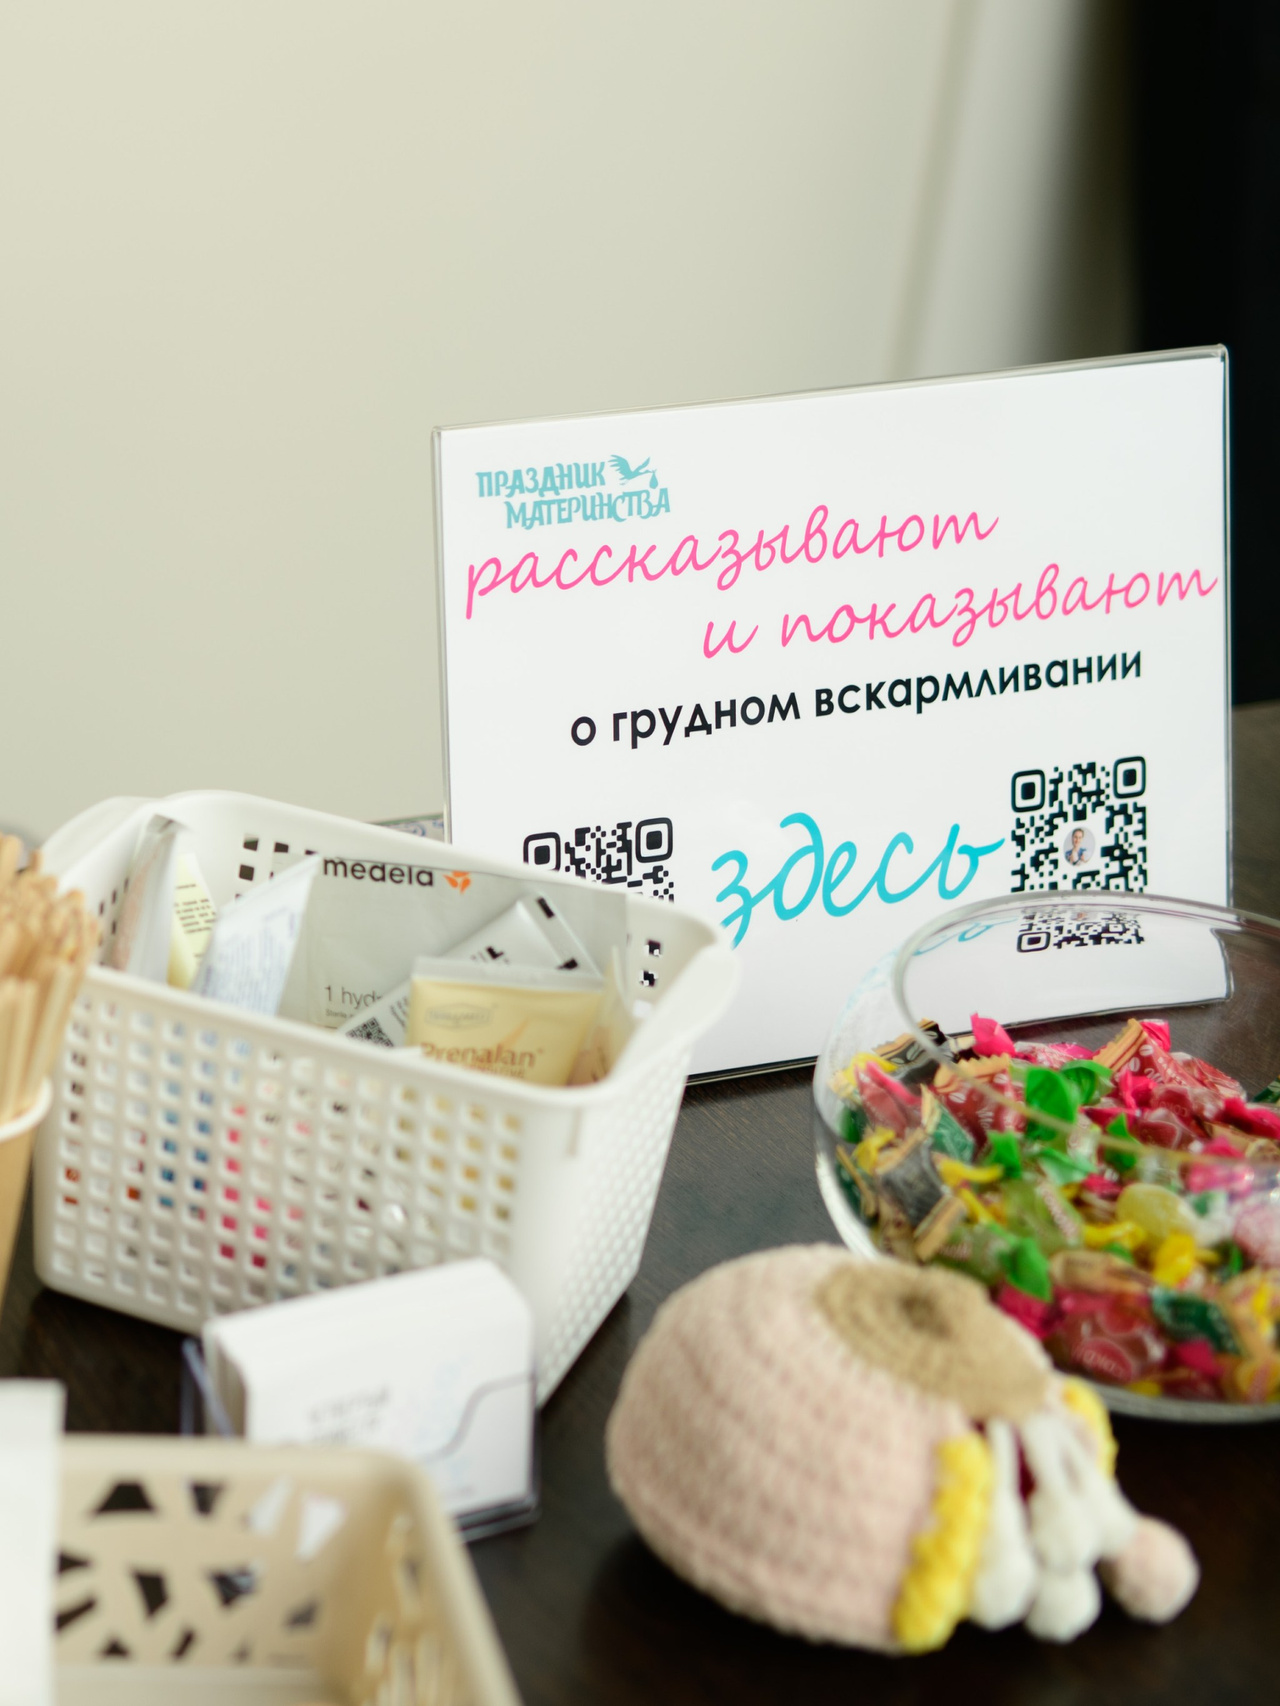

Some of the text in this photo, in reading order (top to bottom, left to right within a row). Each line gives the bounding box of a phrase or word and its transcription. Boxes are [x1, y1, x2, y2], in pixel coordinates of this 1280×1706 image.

[475, 461, 606, 498] ПРАЗДНИК
[504, 487, 671, 530] МАТЕРИНСТВА
[465, 504, 1000, 620] рассказывают
[702, 561, 1218, 660] и показывают
[570, 651, 1142, 750] о грудном вскармливании
[323, 857, 434, 887] medela
[710, 811, 1006, 950] здесь
